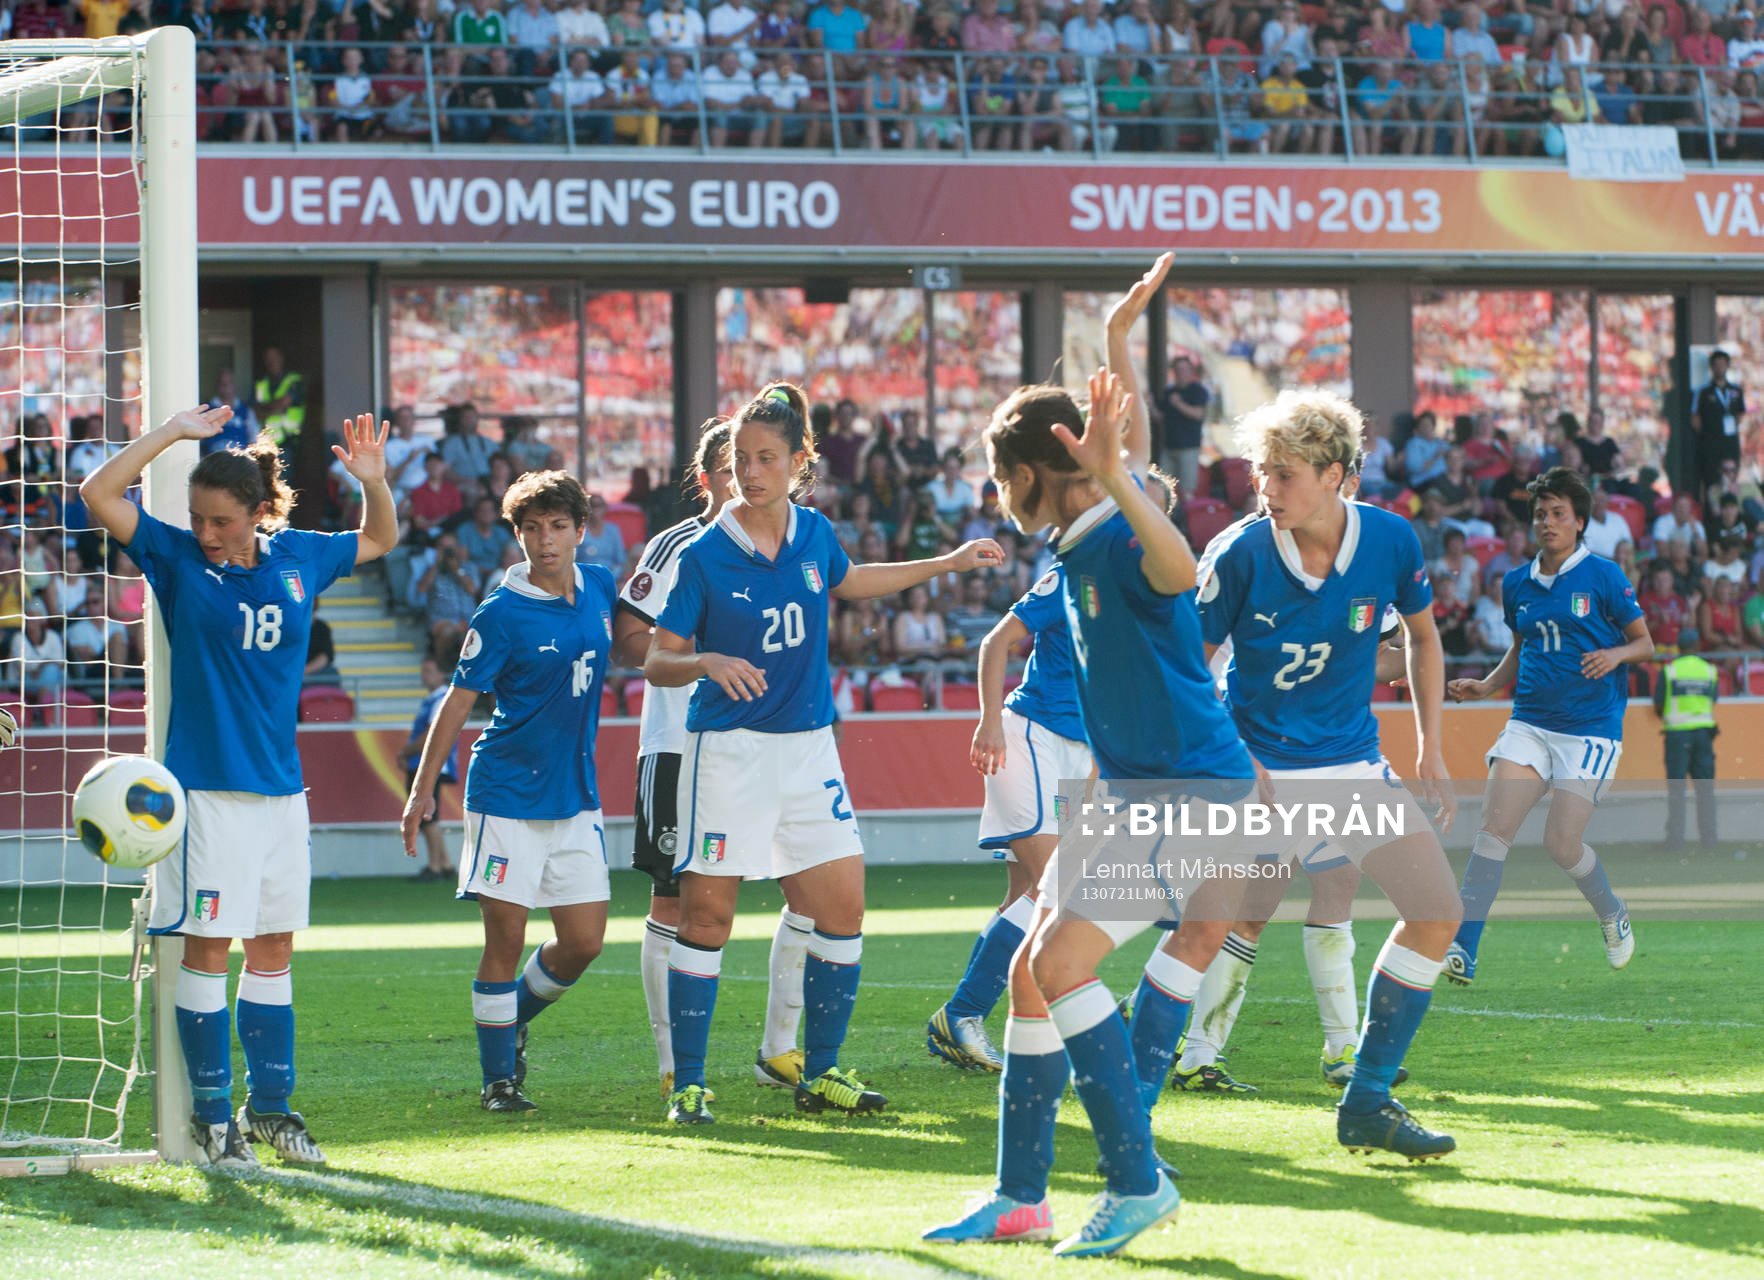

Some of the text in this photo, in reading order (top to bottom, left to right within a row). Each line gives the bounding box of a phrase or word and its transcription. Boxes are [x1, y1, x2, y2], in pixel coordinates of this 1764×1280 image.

[242, 175, 841, 229] UEFA WOMEN'S EURO
[1694, 182, 1764, 237] VÄ
[238, 602, 283, 652] 18
[761, 601, 806, 654] 20
[1535, 619, 1561, 653] 11
[572, 649, 597, 698] 16
[1273, 641, 1332, 691] 23
[1581, 738, 1604, 775] 11
[994, 1201, 1053, 1239] NIKE
